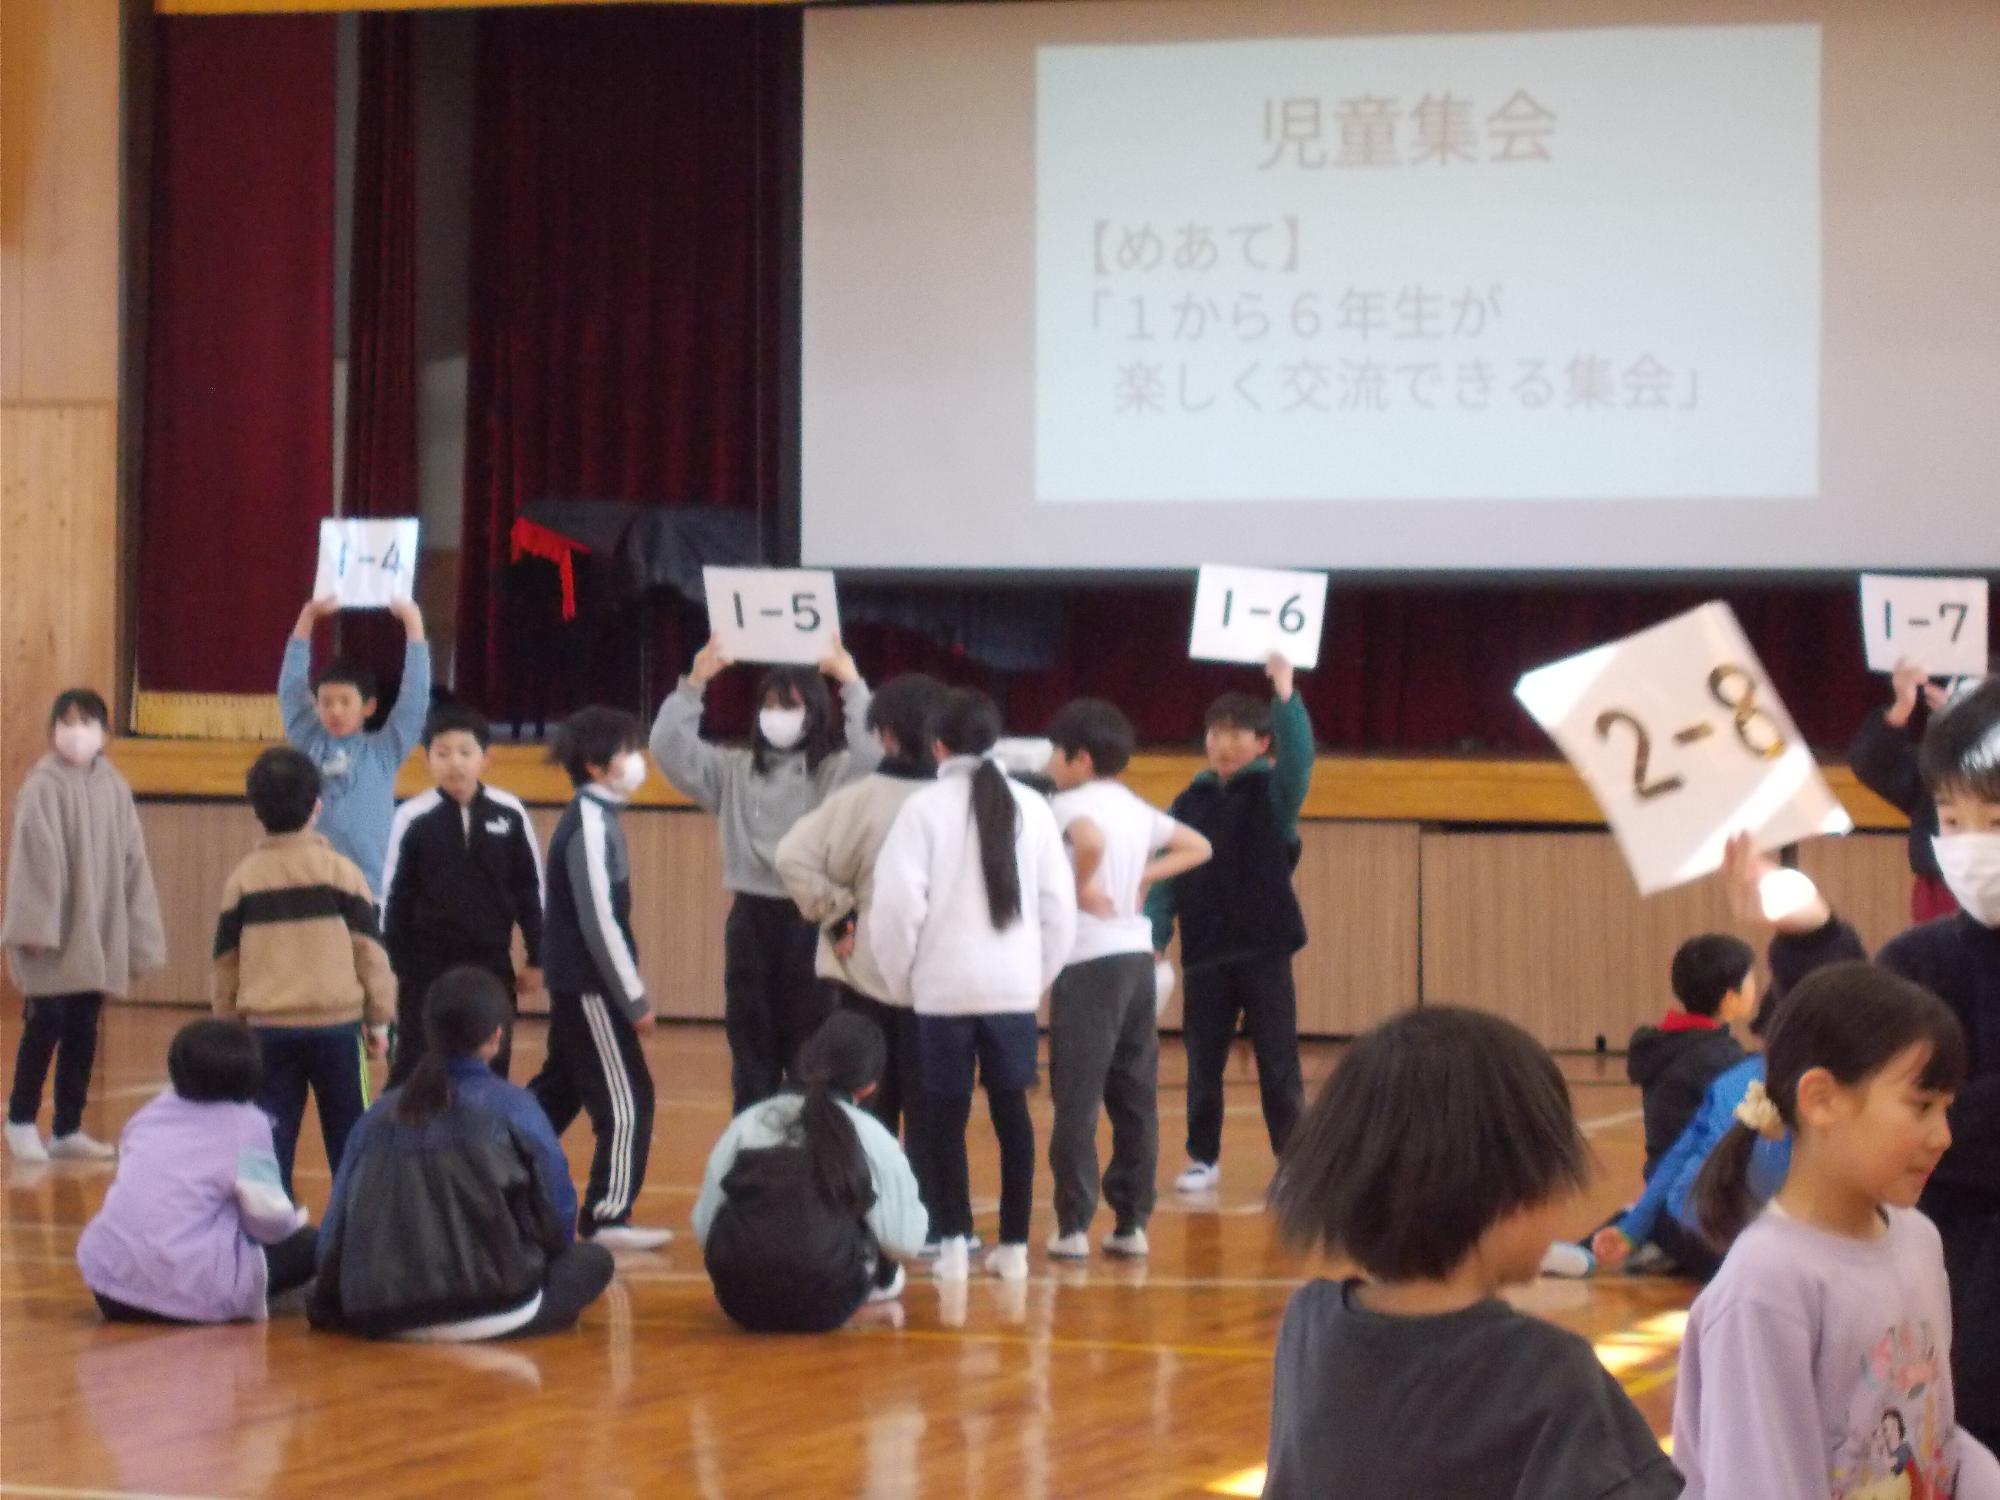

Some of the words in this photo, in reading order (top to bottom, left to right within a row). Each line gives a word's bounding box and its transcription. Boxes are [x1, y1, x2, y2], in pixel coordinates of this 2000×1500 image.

[1256, 87, 1558, 170] 児童集会
[1094, 214, 1299, 276] 【めあて】
[1114, 352, 1700, 416] 楽しく交流できる集会」
[338, 541, 403, 577] 1-4
[732, 590, 822, 633] 1-5
[1221, 588, 1306, 635] 1-6
[1884, 600, 1968, 642] 1-7
[1595, 663, 1785, 799] 2-8
